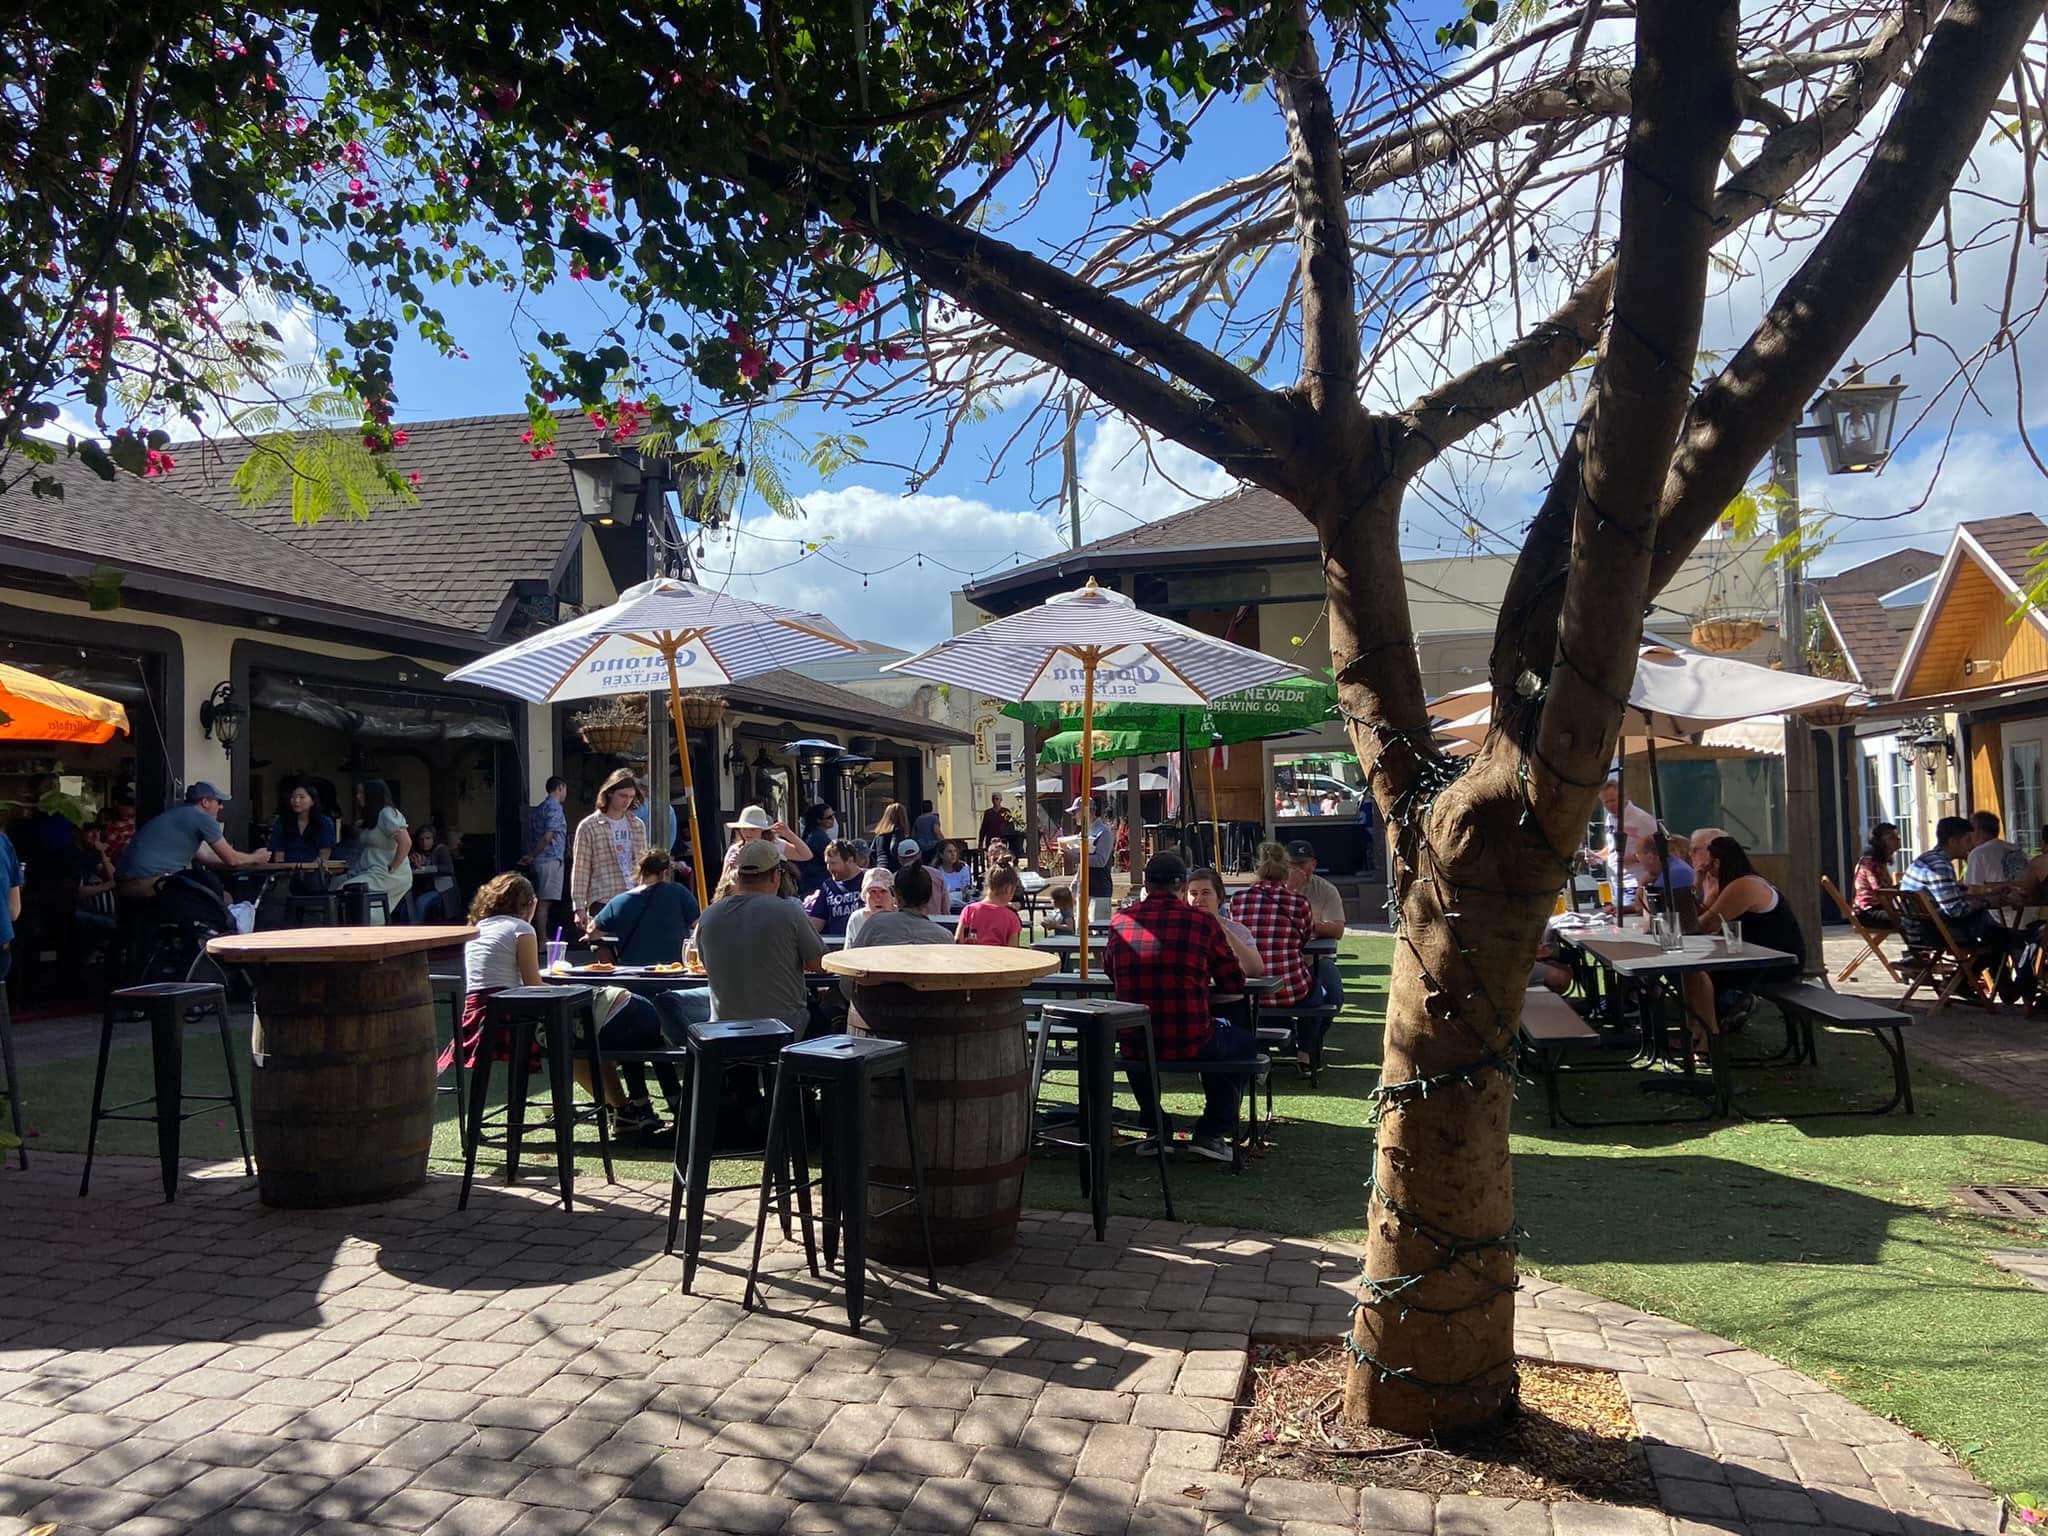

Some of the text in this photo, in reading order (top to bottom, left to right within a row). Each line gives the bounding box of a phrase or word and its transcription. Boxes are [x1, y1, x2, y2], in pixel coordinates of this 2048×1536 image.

[1244, 687, 1305, 702] NEVADA
[1206, 701, 1260, 712] BREWING
[826, 890, 862, 906] FLORID
